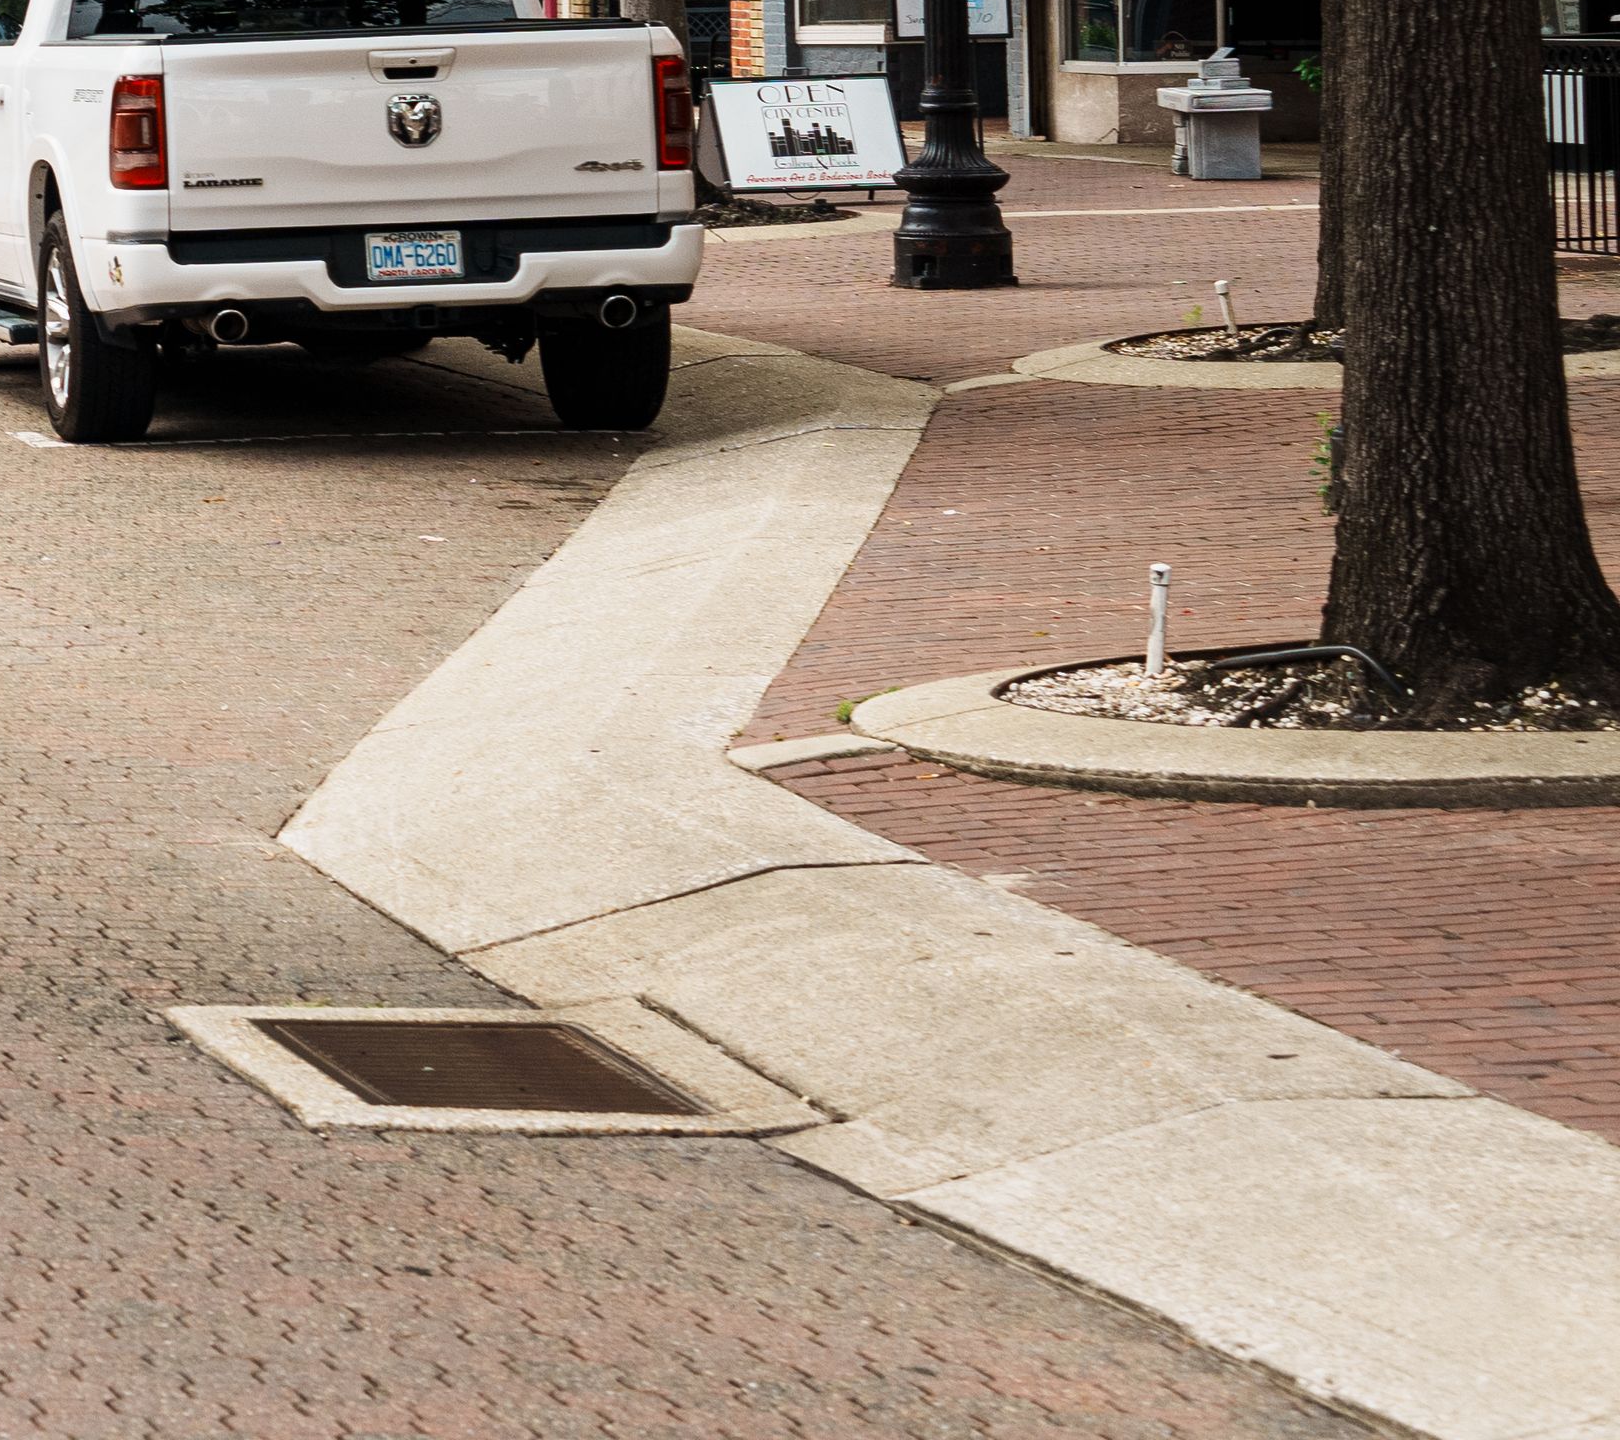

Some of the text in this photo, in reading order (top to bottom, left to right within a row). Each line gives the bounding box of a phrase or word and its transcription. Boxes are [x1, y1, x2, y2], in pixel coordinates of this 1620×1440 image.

[757, 83, 847, 105] OPEN
[764, 106, 846, 119] CITY CENTER
[774, 158, 814, 169] Gallery
[746, 174, 788, 184] Awesome
[790, 172, 805, 182] Art
[820, 171, 863, 181] Bodacious
[866, 169, 892, 180] Books
[183, 178, 263, 189] LARAMIE
[389, 232, 438, 241] CROWN
